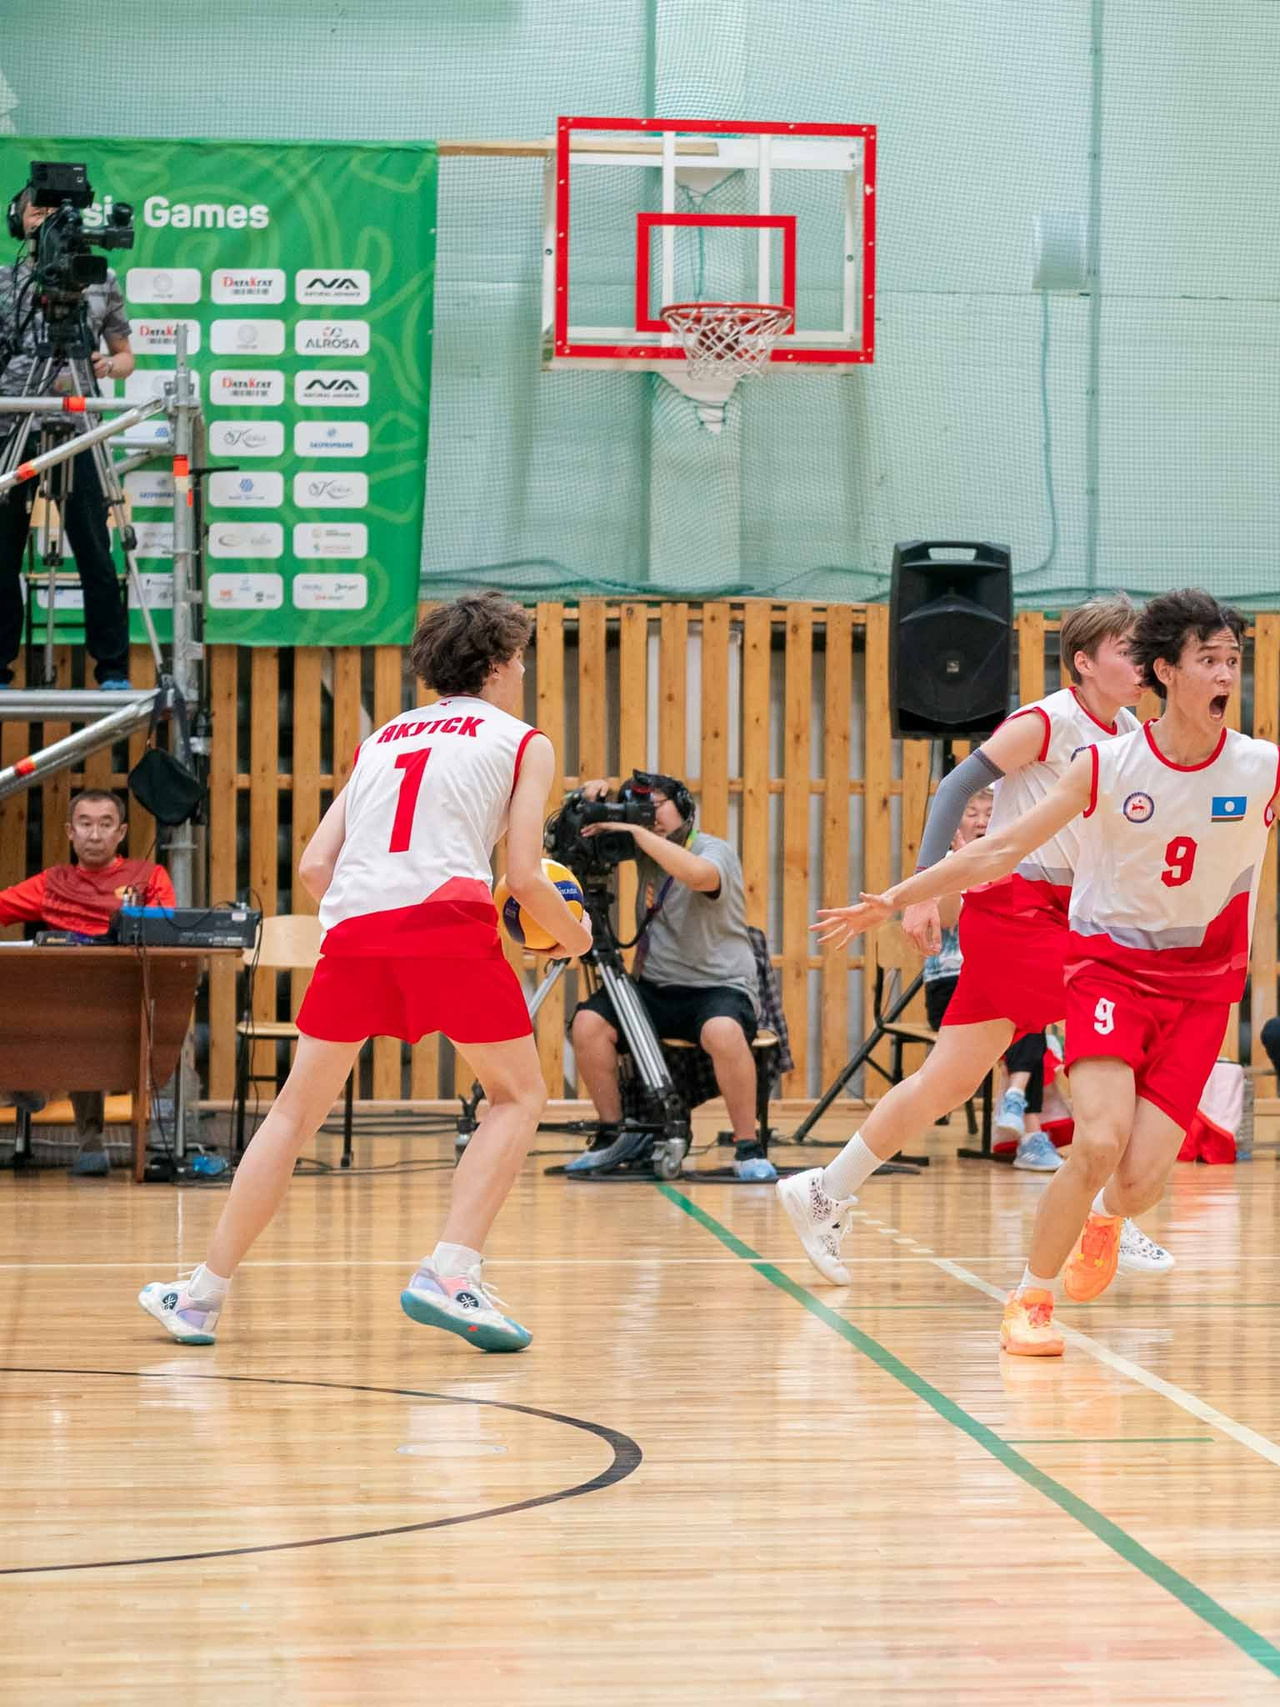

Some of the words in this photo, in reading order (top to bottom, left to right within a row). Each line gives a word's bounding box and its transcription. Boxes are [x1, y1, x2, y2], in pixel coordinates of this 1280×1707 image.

[144, 196, 269, 228] Games
[305, 338, 360, 349] ALROSA
[376, 716, 485, 744] ЯКУТСК
[389, 748, 432, 853] 1
[1161, 836, 1198, 888] 9
[1094, 998, 1116, 1035] 9
